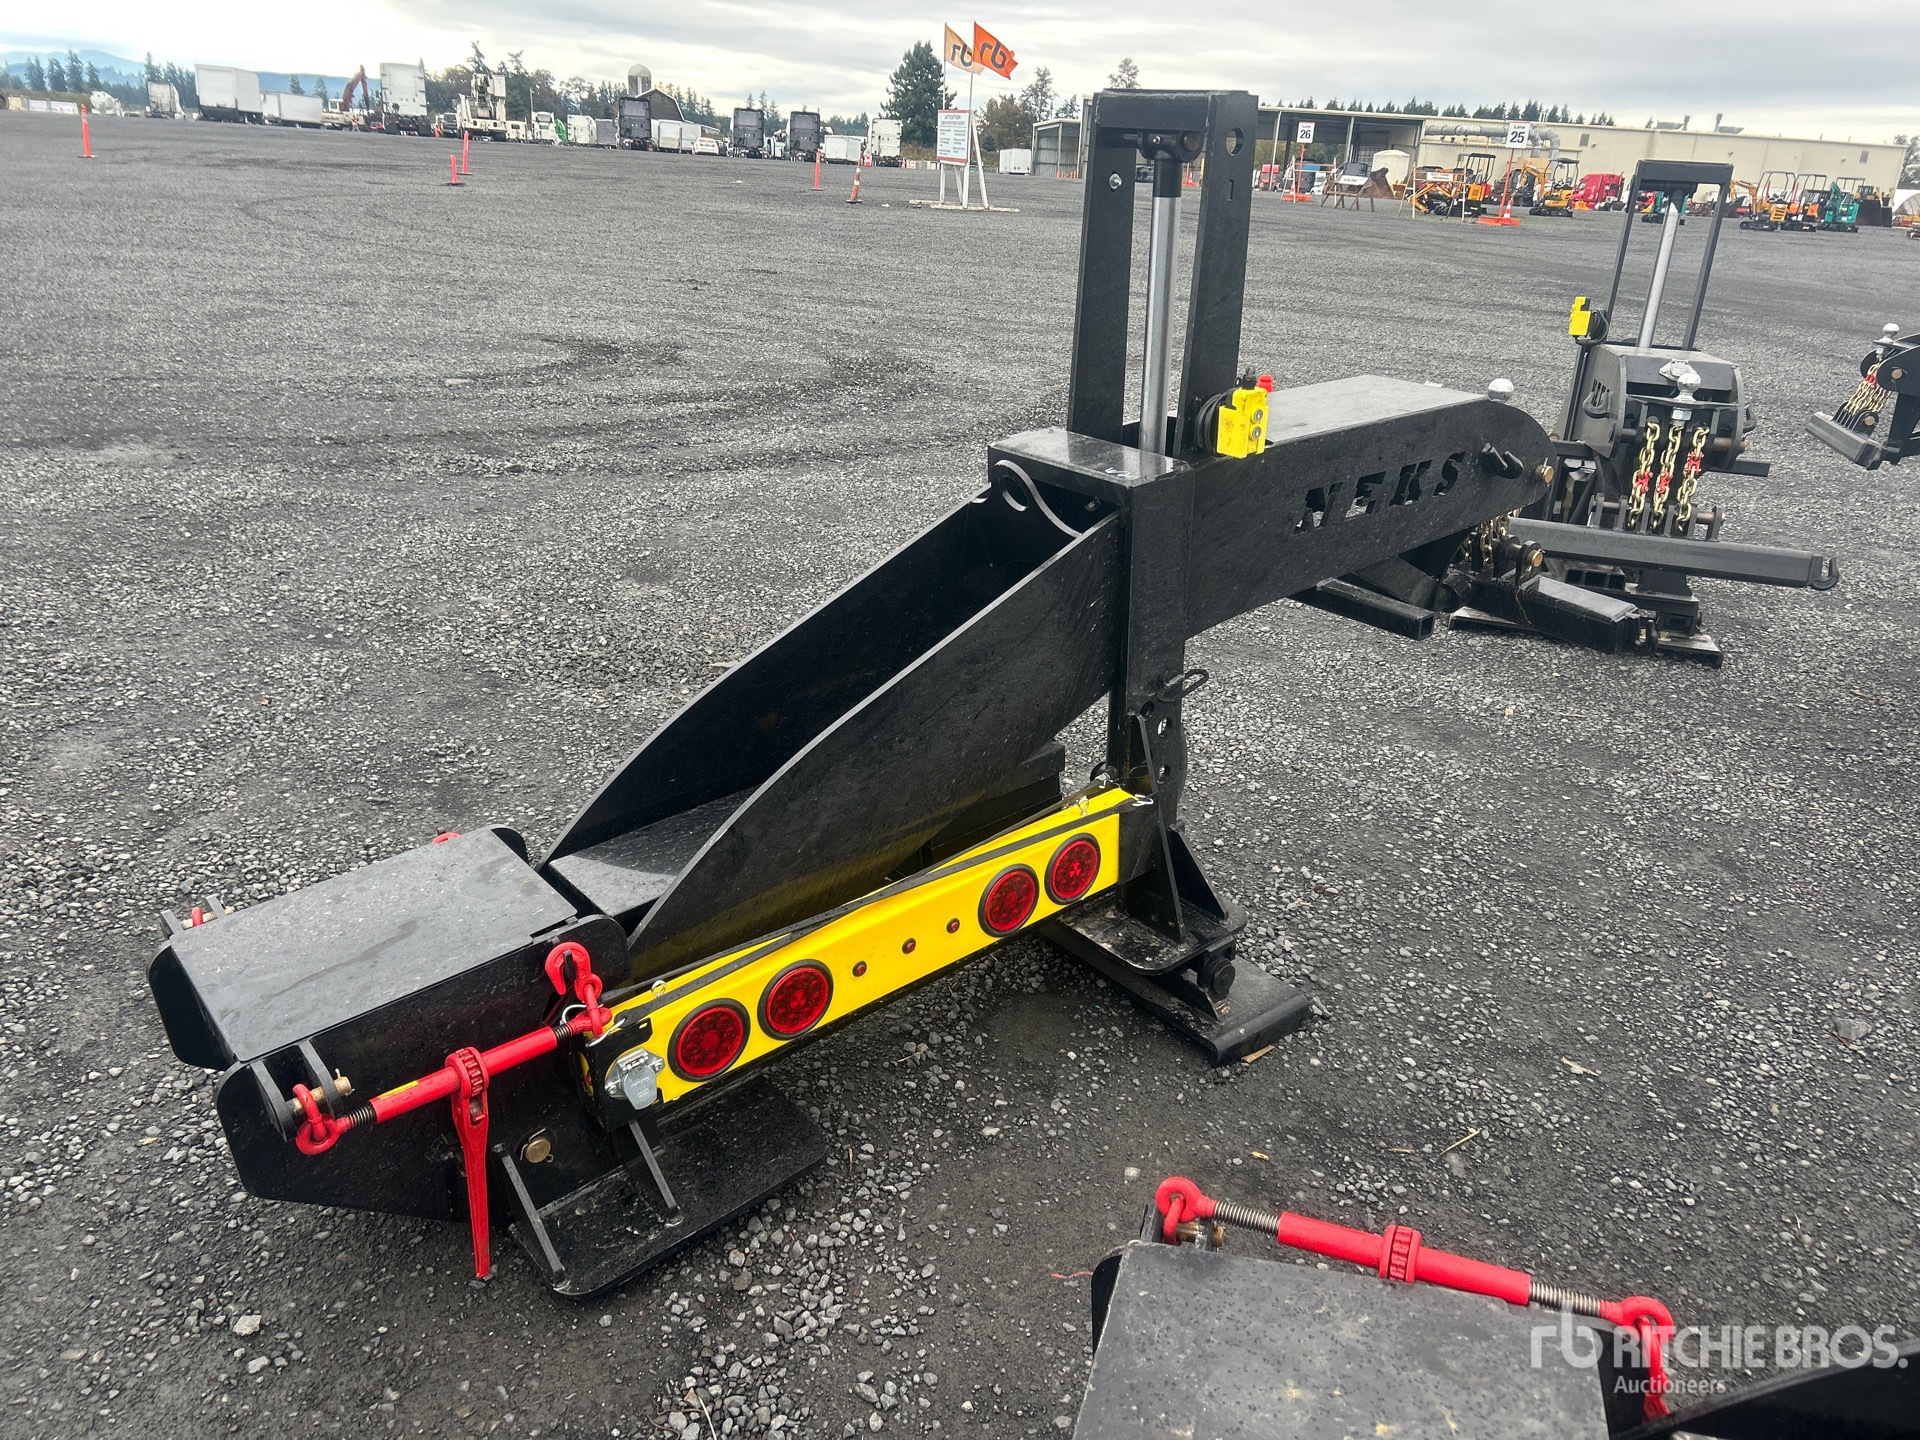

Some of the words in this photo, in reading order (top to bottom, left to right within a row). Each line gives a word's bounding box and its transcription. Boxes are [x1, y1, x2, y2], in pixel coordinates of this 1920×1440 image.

[951, 43, 972, 67] rb
[980, 40, 1006, 69] rb
[1300, 129, 1311, 139] 26
[1509, 130, 1525, 143] 25
[1294, 451, 1466, 534] NEKS
